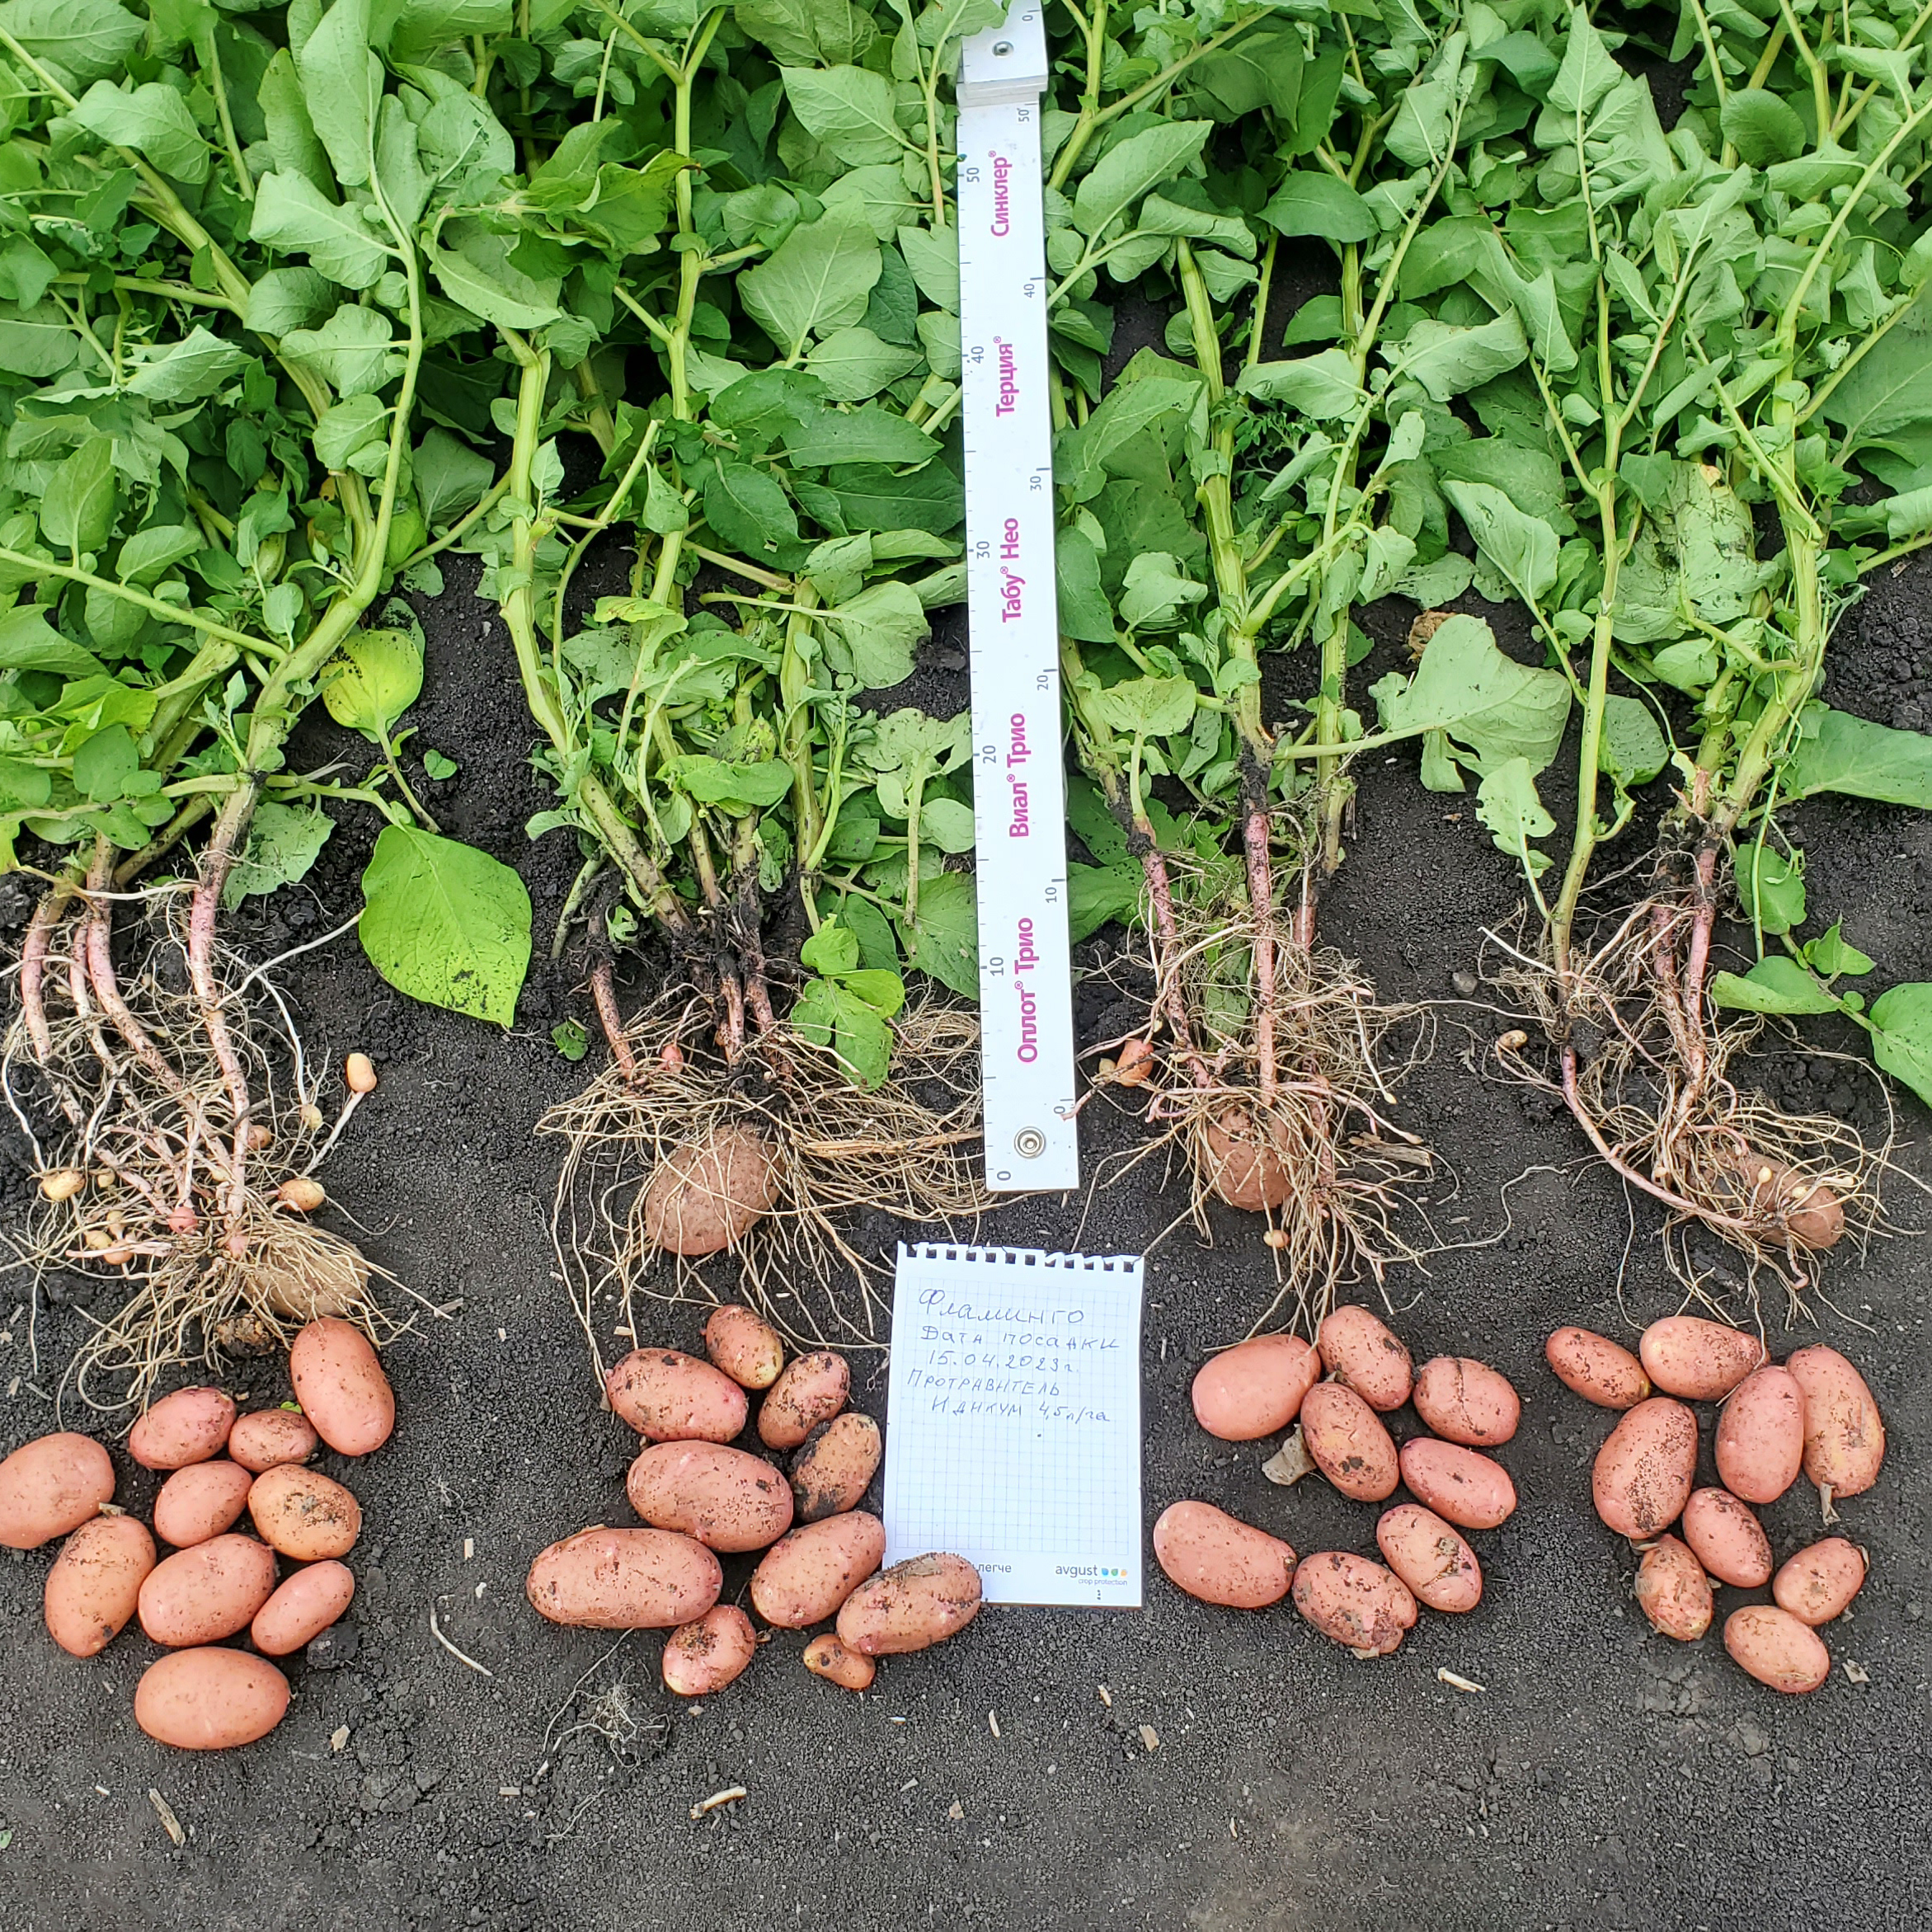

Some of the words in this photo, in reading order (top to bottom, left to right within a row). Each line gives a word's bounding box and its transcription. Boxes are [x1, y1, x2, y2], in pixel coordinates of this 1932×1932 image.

[1022, 14, 1033, 22] 0
[1018, 108, 1030, 123] 50
[966, 167, 980, 183] 50
[1022, 283, 1036, 298] 40
[971, 346, 985, 364] 40
[1029, 476, 1042, 491] 30
[999, 517, 1019, 560] Нео
[975, 541, 990, 560] 30
[1036, 675, 1049, 691] 20
[1006, 712, 1032, 769] Трио
[981, 745, 997, 764] 20
[1044, 886, 1057, 904] 10
[1013, 917, 1040, 975] Трио
[989, 957, 1004, 976] 10
[1052, 1106, 1066, 1115] 0
[996, 1170, 1012, 1182] 0
[919, 1288, 1084, 1324] Фламинго
[920, 1325, 983, 1345] Дата
[1003, 1333, 1121, 1351] посадки
[978, 1563, 1012, 1573] легче
[1055, 1564, 1098, 1578] avgust
